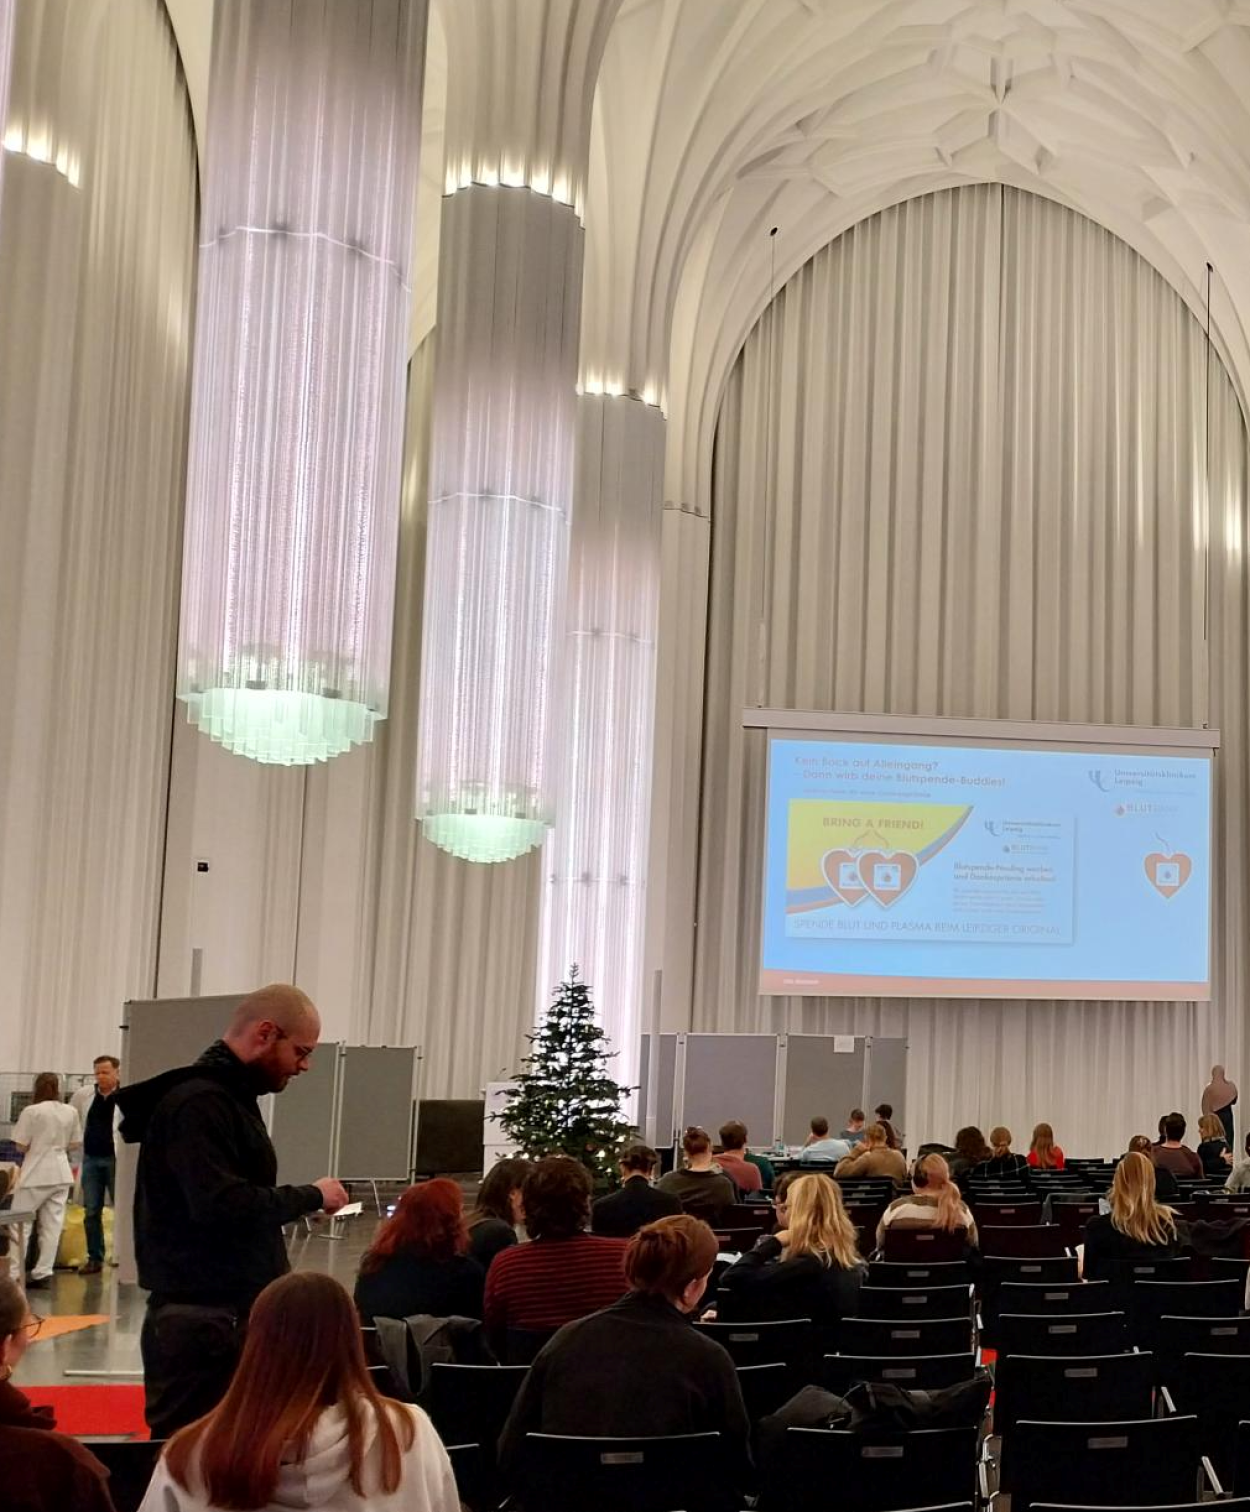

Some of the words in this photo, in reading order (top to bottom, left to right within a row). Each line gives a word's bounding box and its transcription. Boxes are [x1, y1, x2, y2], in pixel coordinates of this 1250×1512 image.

[822, 817, 861, 829] BRING
[865, 818, 876, 829] A
[878, 818, 924, 830] FRIEND!
[891, 920, 933, 932] PLASMA
